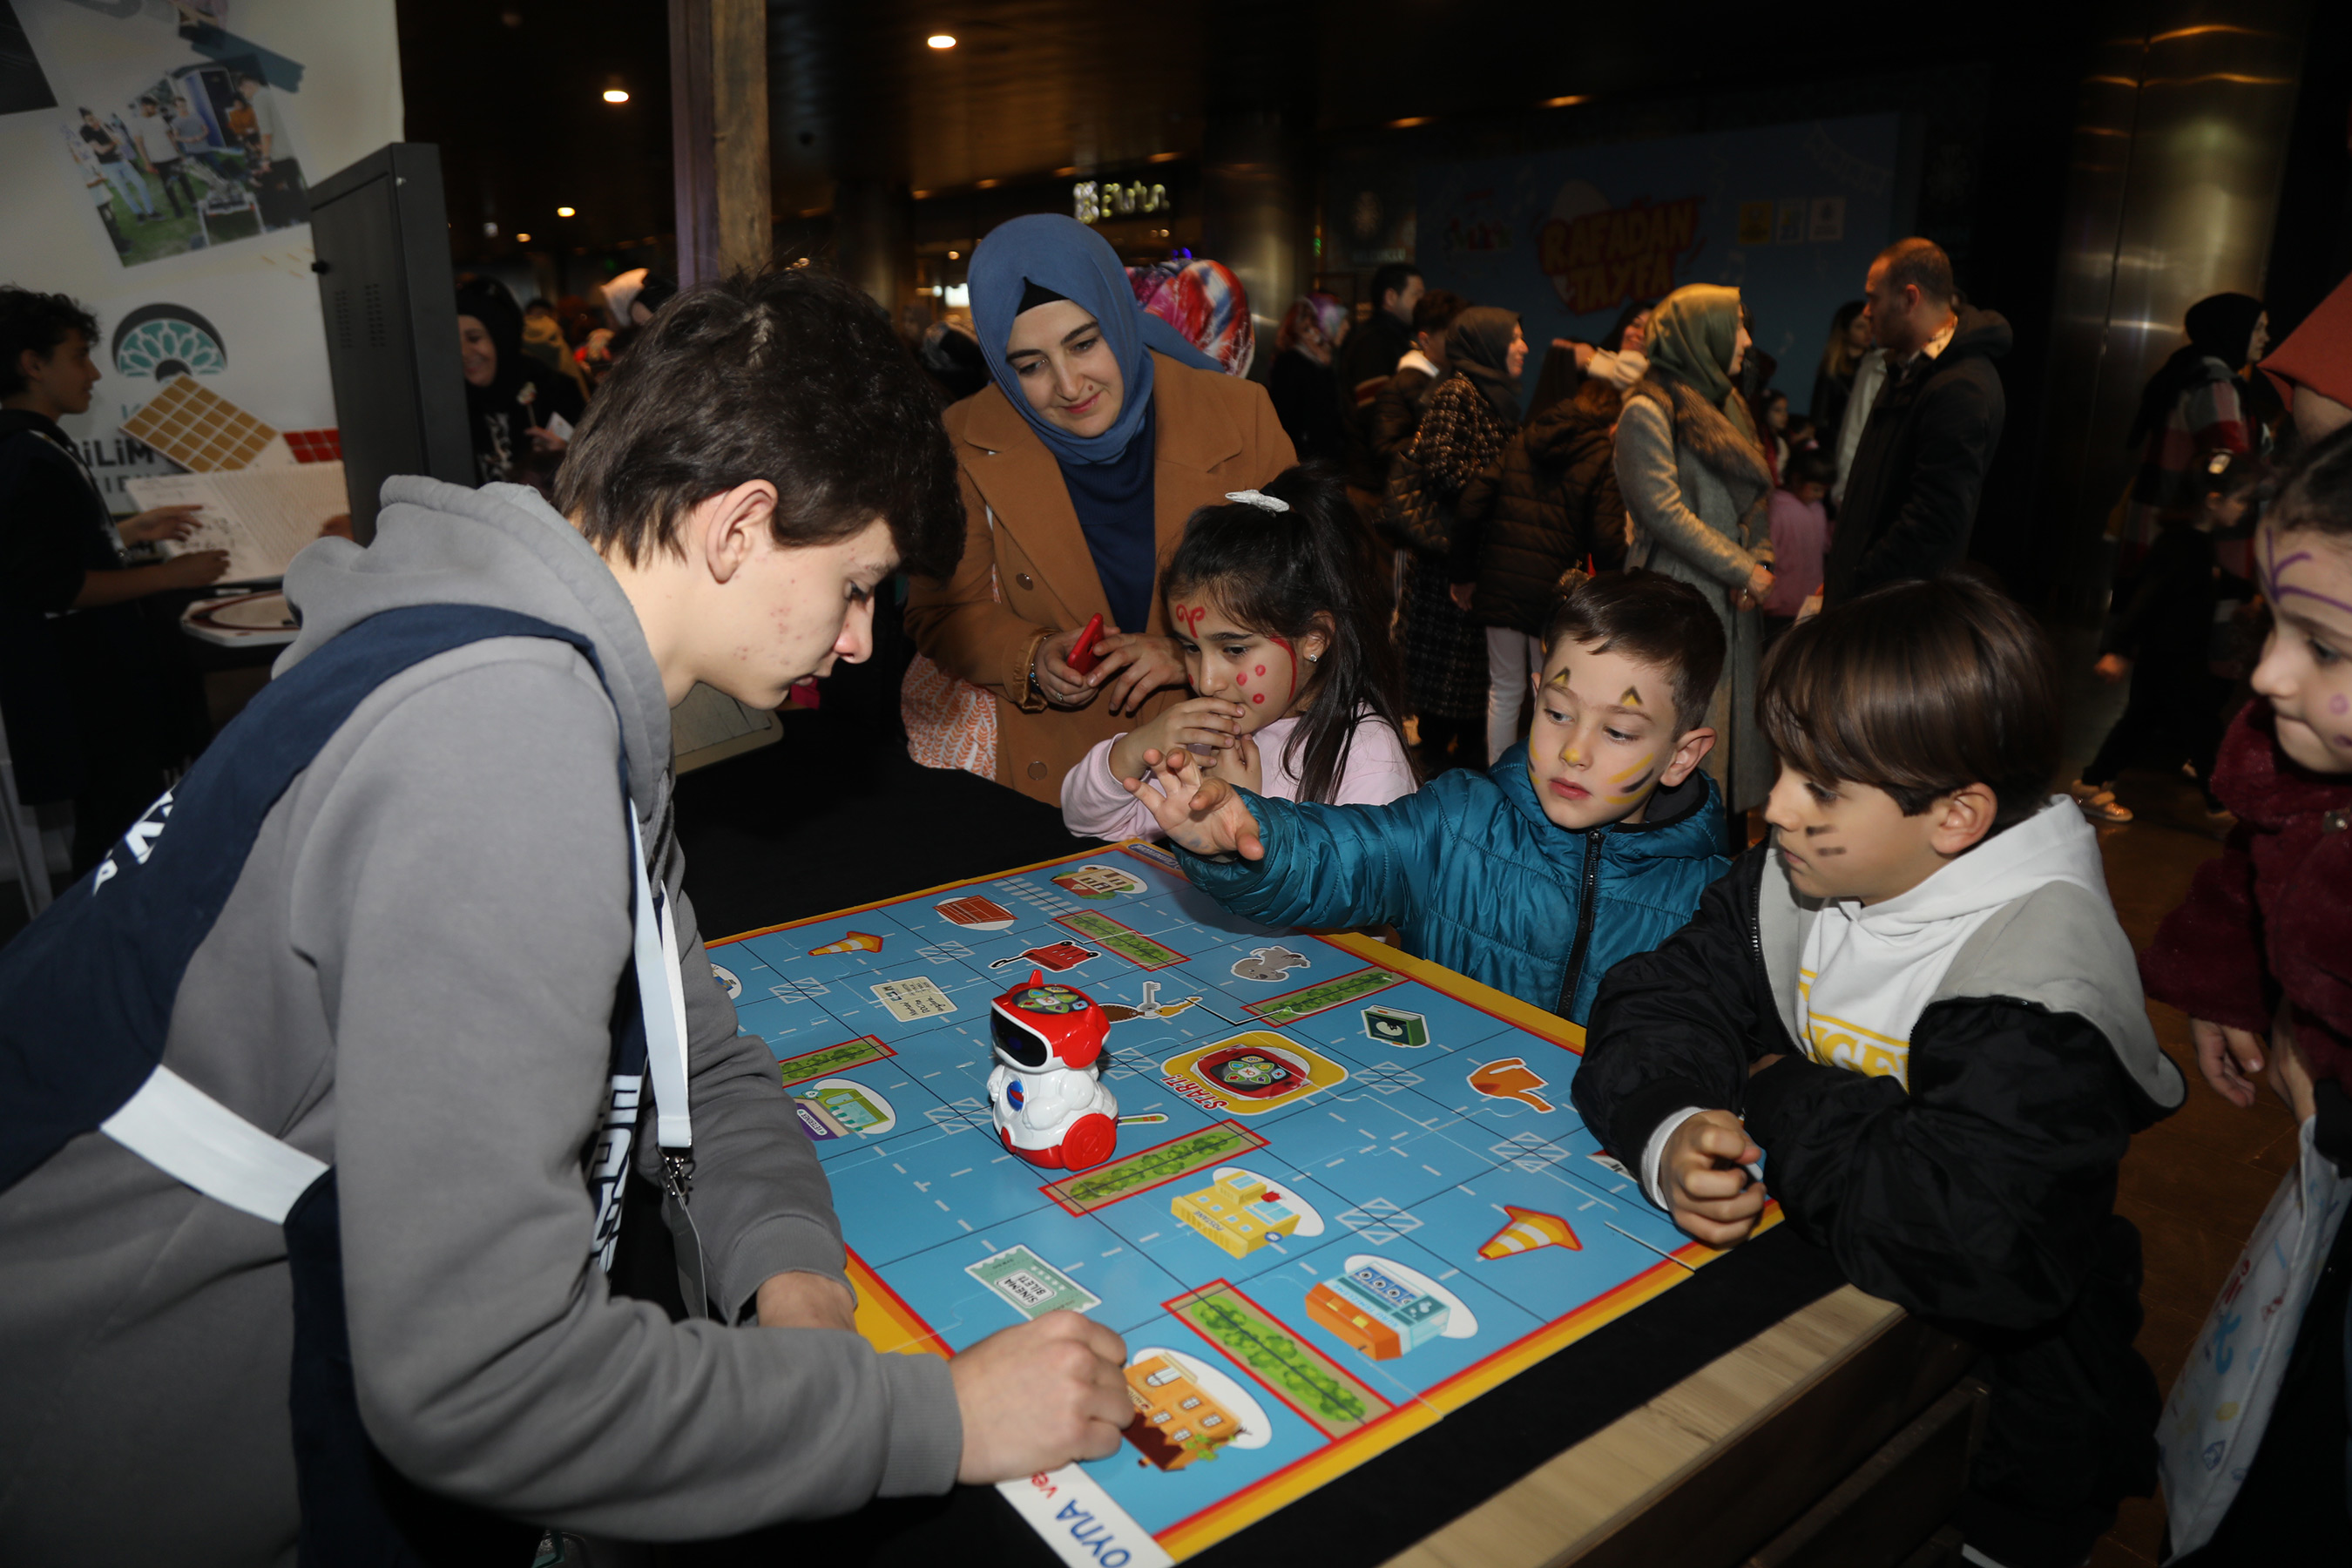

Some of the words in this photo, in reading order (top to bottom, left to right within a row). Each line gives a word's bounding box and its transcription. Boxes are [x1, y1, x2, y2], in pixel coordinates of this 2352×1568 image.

[1541, 199, 1696, 274] RAFADAN
[1568, 251, 1674, 314] TAYFA
[1160, 1074, 1229, 1111] START!
[1031, 1471, 1059, 1499] ve
